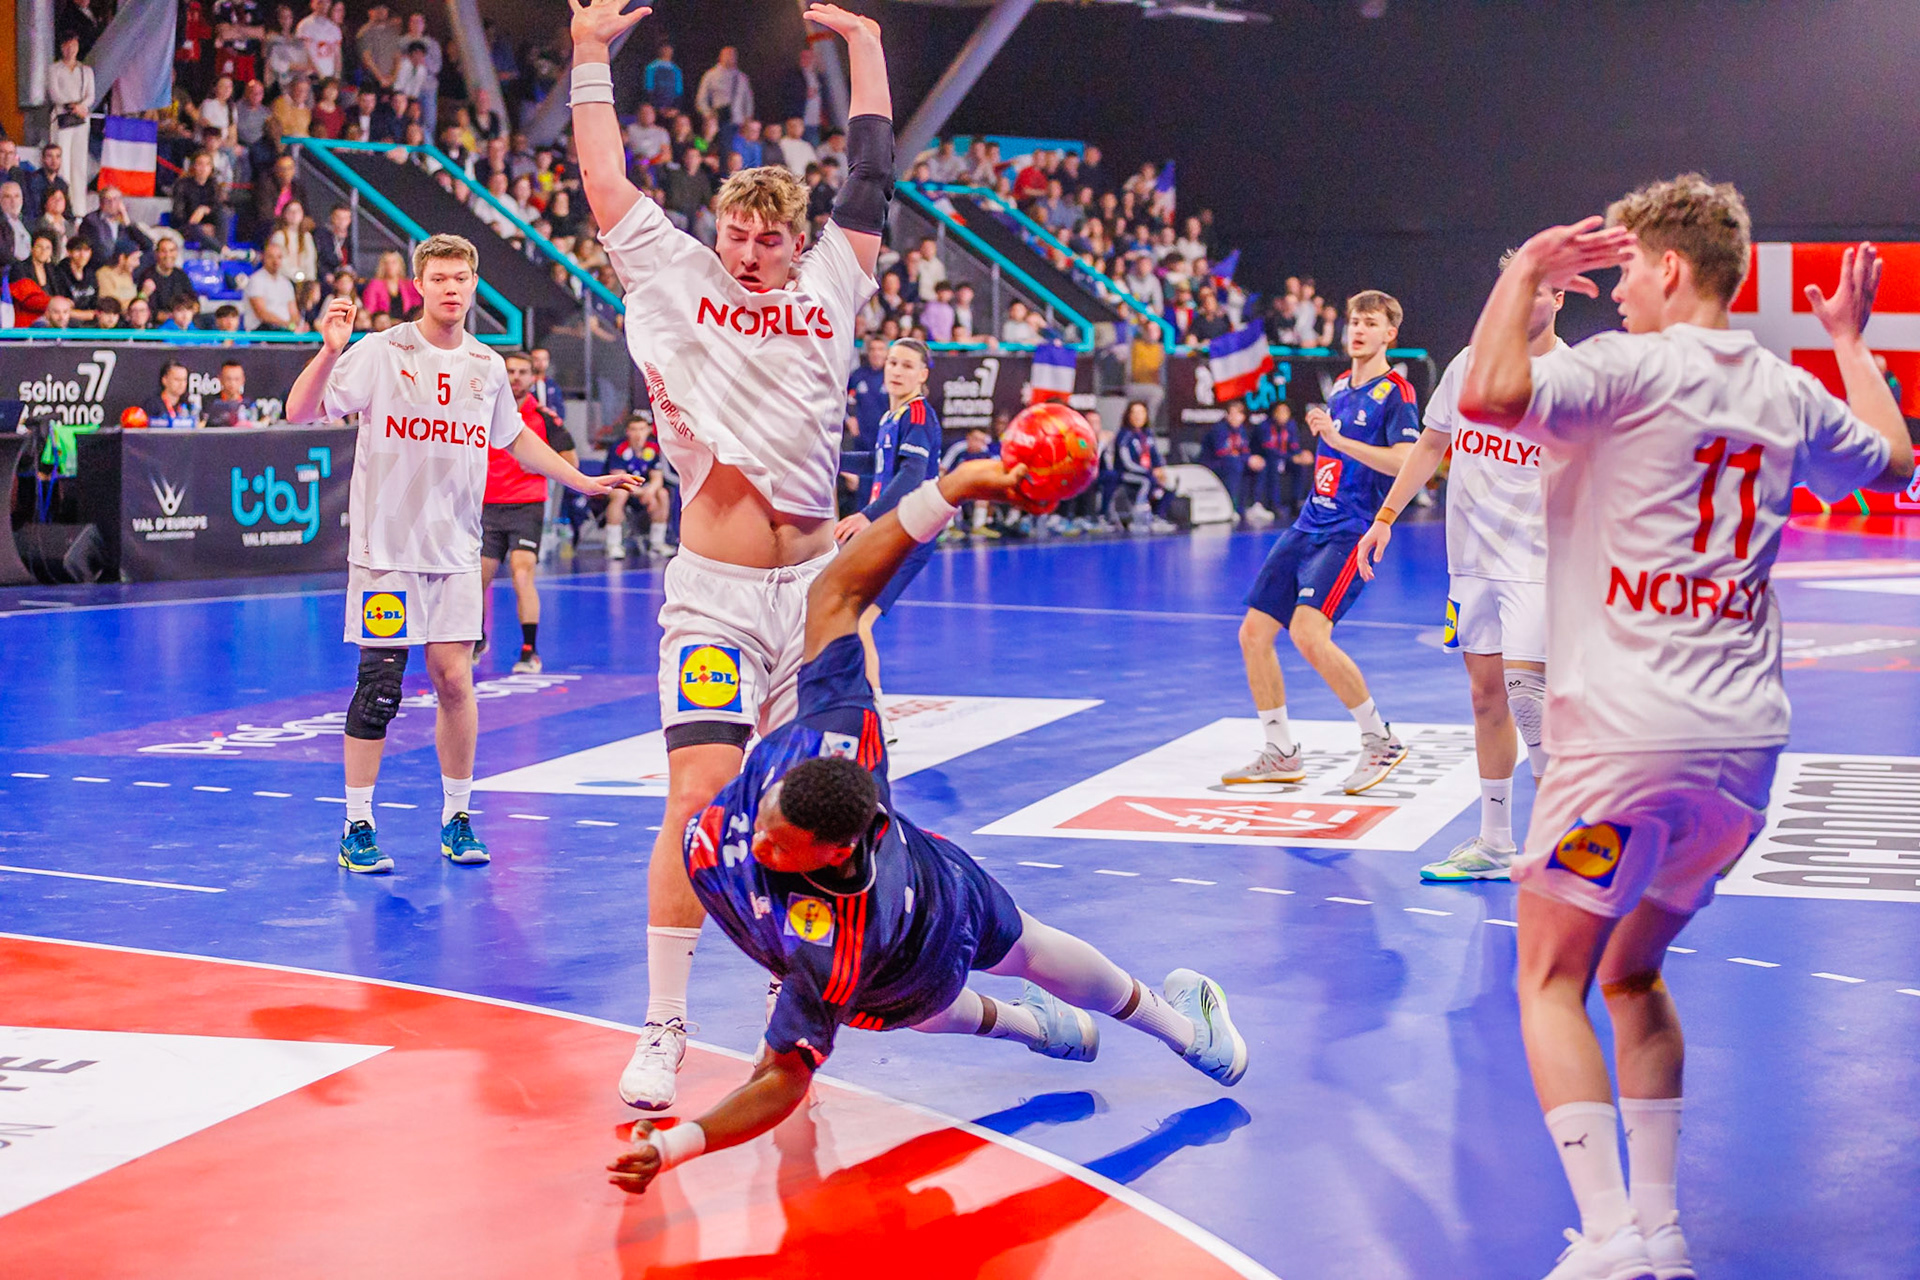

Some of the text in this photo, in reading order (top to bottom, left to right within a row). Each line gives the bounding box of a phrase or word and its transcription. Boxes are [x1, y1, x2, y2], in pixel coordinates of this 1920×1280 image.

[697, 296, 834, 339] NORLYS
[19, 373, 81, 403] seine
[437, 372, 451, 406] 5
[385, 415, 487, 449] NORLYS
[1692, 436, 1765, 560] 11
[1605, 566, 1767, 621] NORLY
